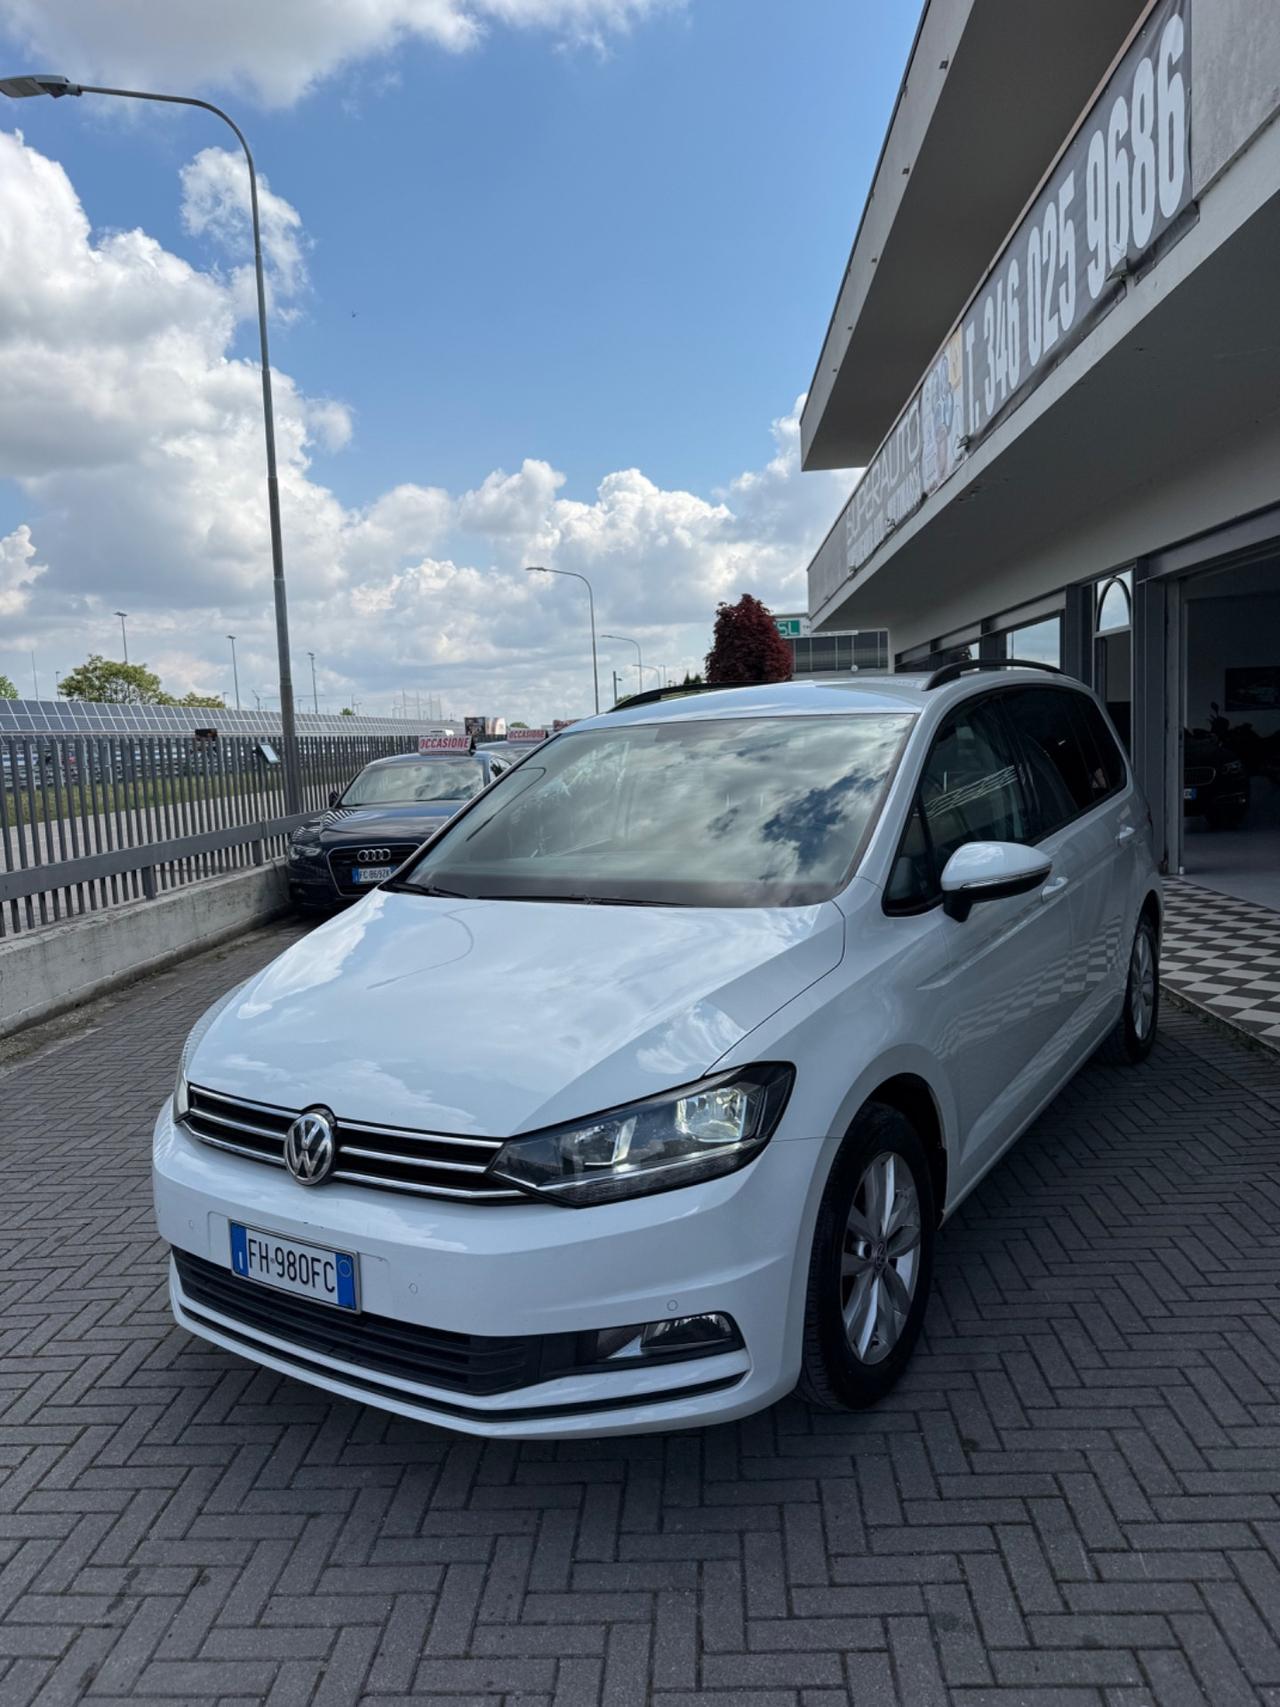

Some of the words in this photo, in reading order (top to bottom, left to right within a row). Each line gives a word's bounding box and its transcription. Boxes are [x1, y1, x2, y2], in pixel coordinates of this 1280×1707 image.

[1027, 171, 1076, 367] 025
[1086, 13, 1185, 299] 9686
[420, 737, 469, 750] OCCASIONE
[248, 1239, 270, 1274] FH
[274, 1247, 336, 1293] 980FC
